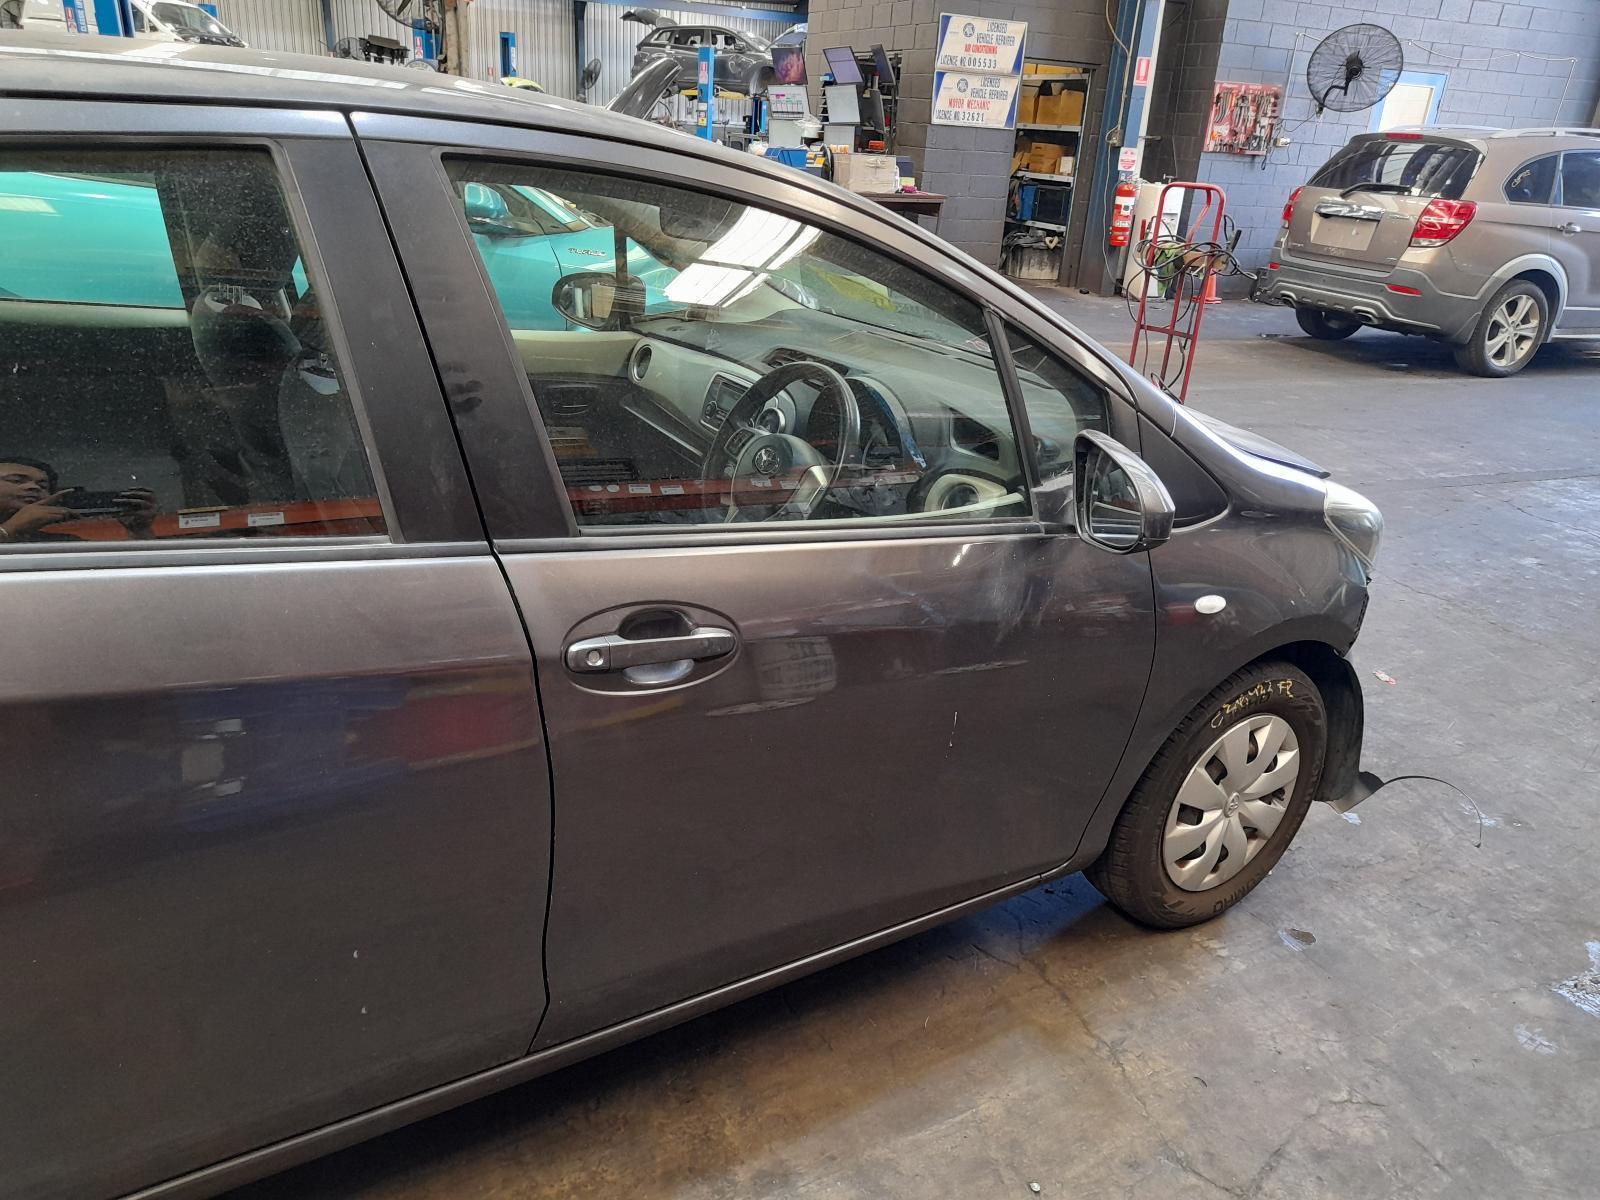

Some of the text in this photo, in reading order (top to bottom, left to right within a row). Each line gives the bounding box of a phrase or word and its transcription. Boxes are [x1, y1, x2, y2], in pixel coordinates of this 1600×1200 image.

[987, 21, 1008, 33] LICENSED
[976, 33, 1015, 46] VEHICLE REPAIRER
[972, 44, 998, 54] CONDITIONING
[967, 57, 997, 69] 005533
[981, 76, 1001, 88] LICENSED
[970, 88, 1009, 100] VEHICLE REPAIRER
[948, 98, 991, 111] MOTOR MECHANIC
[961, 111, 985, 122] 32621
